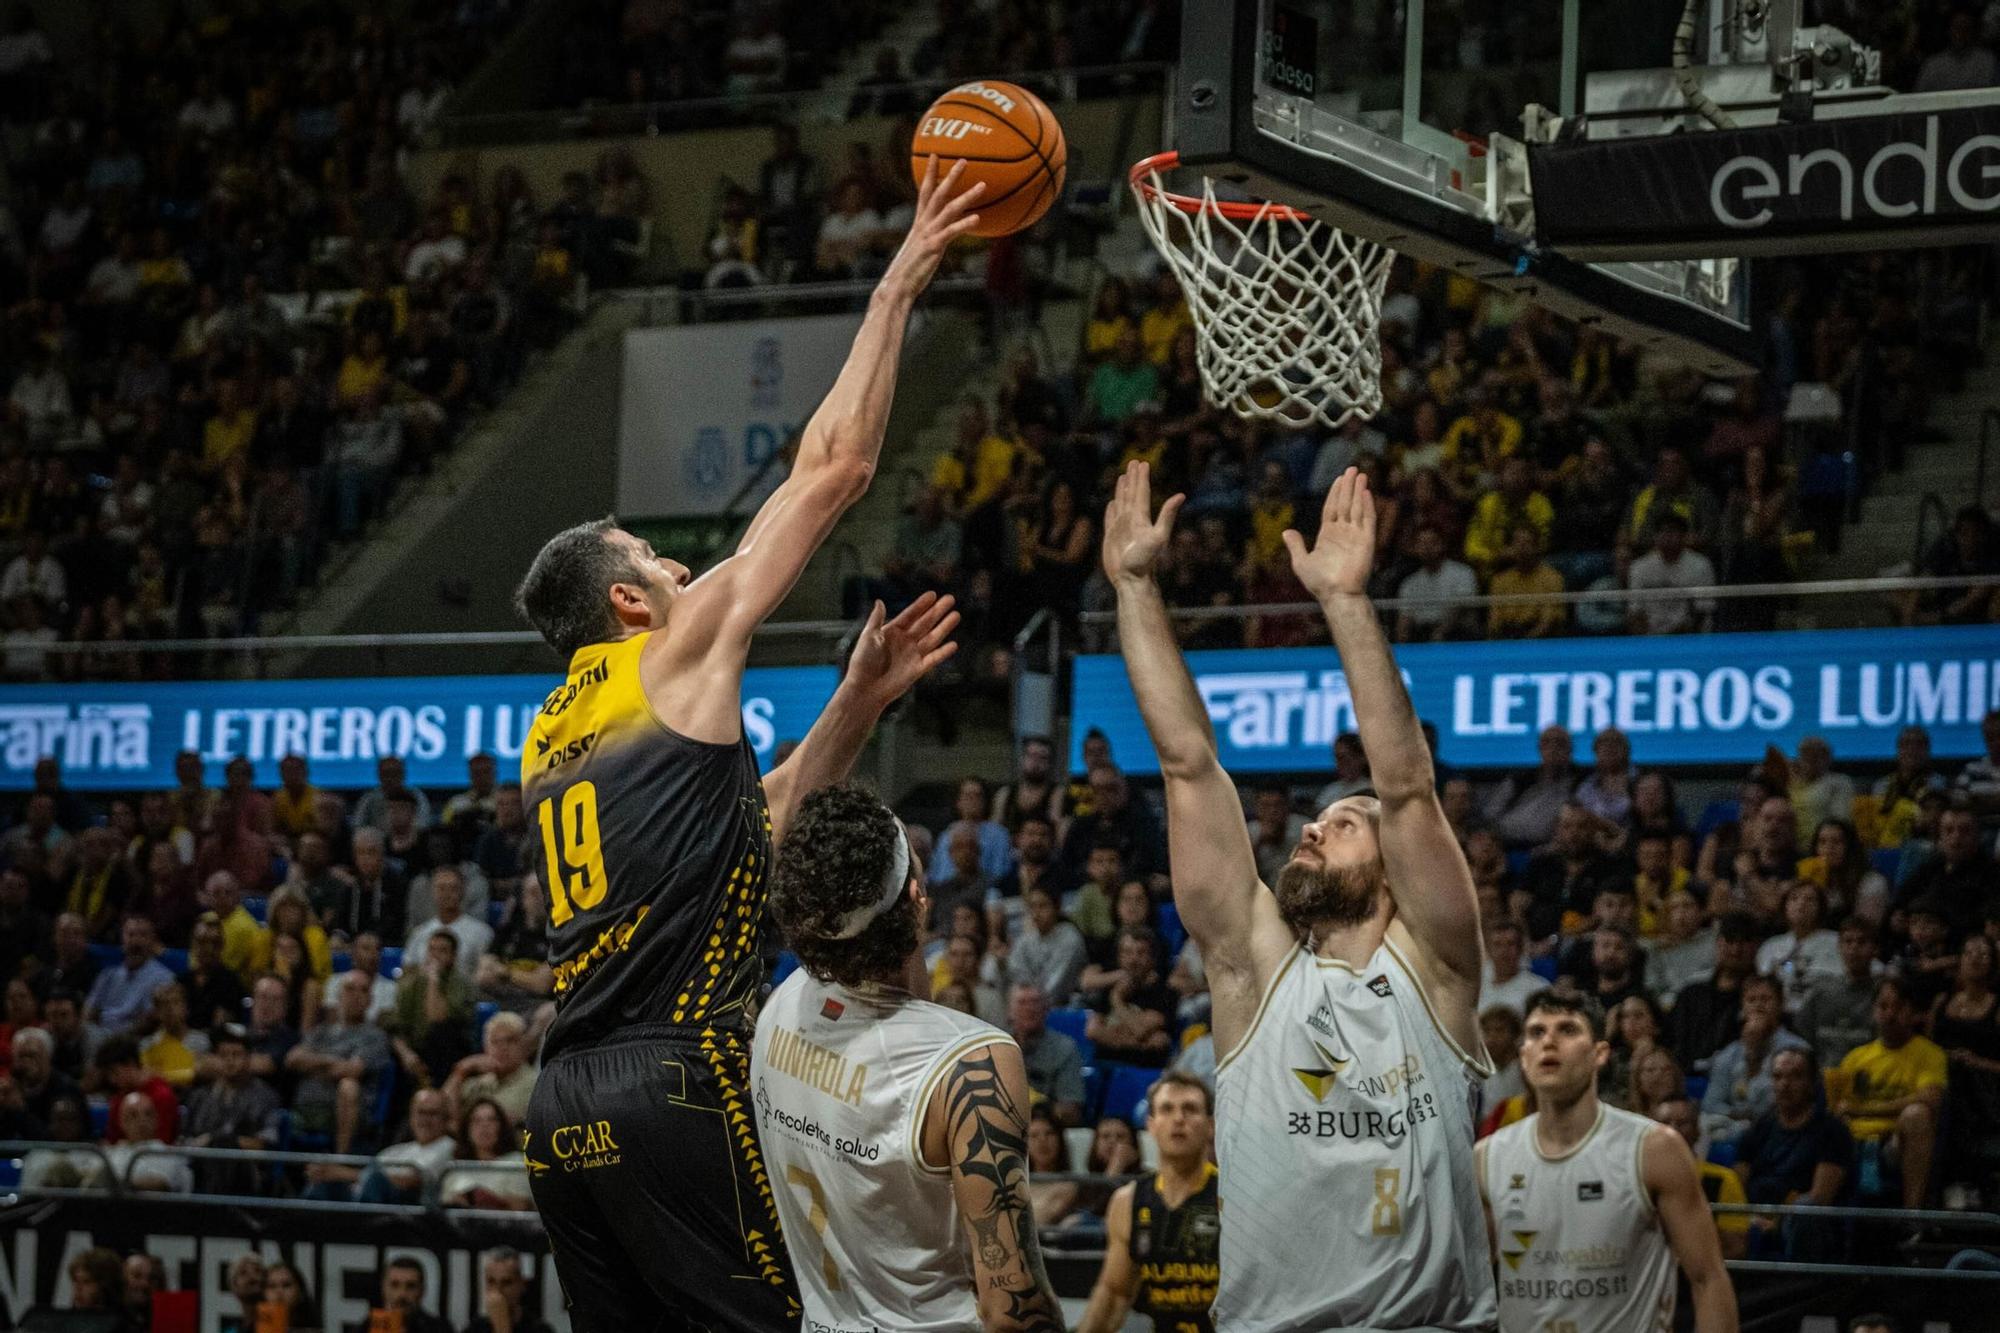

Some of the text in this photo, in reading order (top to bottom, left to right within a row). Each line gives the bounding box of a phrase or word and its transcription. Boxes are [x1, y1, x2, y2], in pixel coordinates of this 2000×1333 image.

[1453, 664, 1794, 737] LETREROS
[183, 704, 447, 761] LETREROS
[538, 780, 608, 928] 19
[605, 1152, 621, 1166] Car
[774, 1108, 831, 1146] recoletas
[834, 1138, 880, 1161] salud
[1372, 1168, 1401, 1237] 8
[988, 1273, 1020, 1289] ARC
[1515, 1276, 1610, 1300] BURGOS
